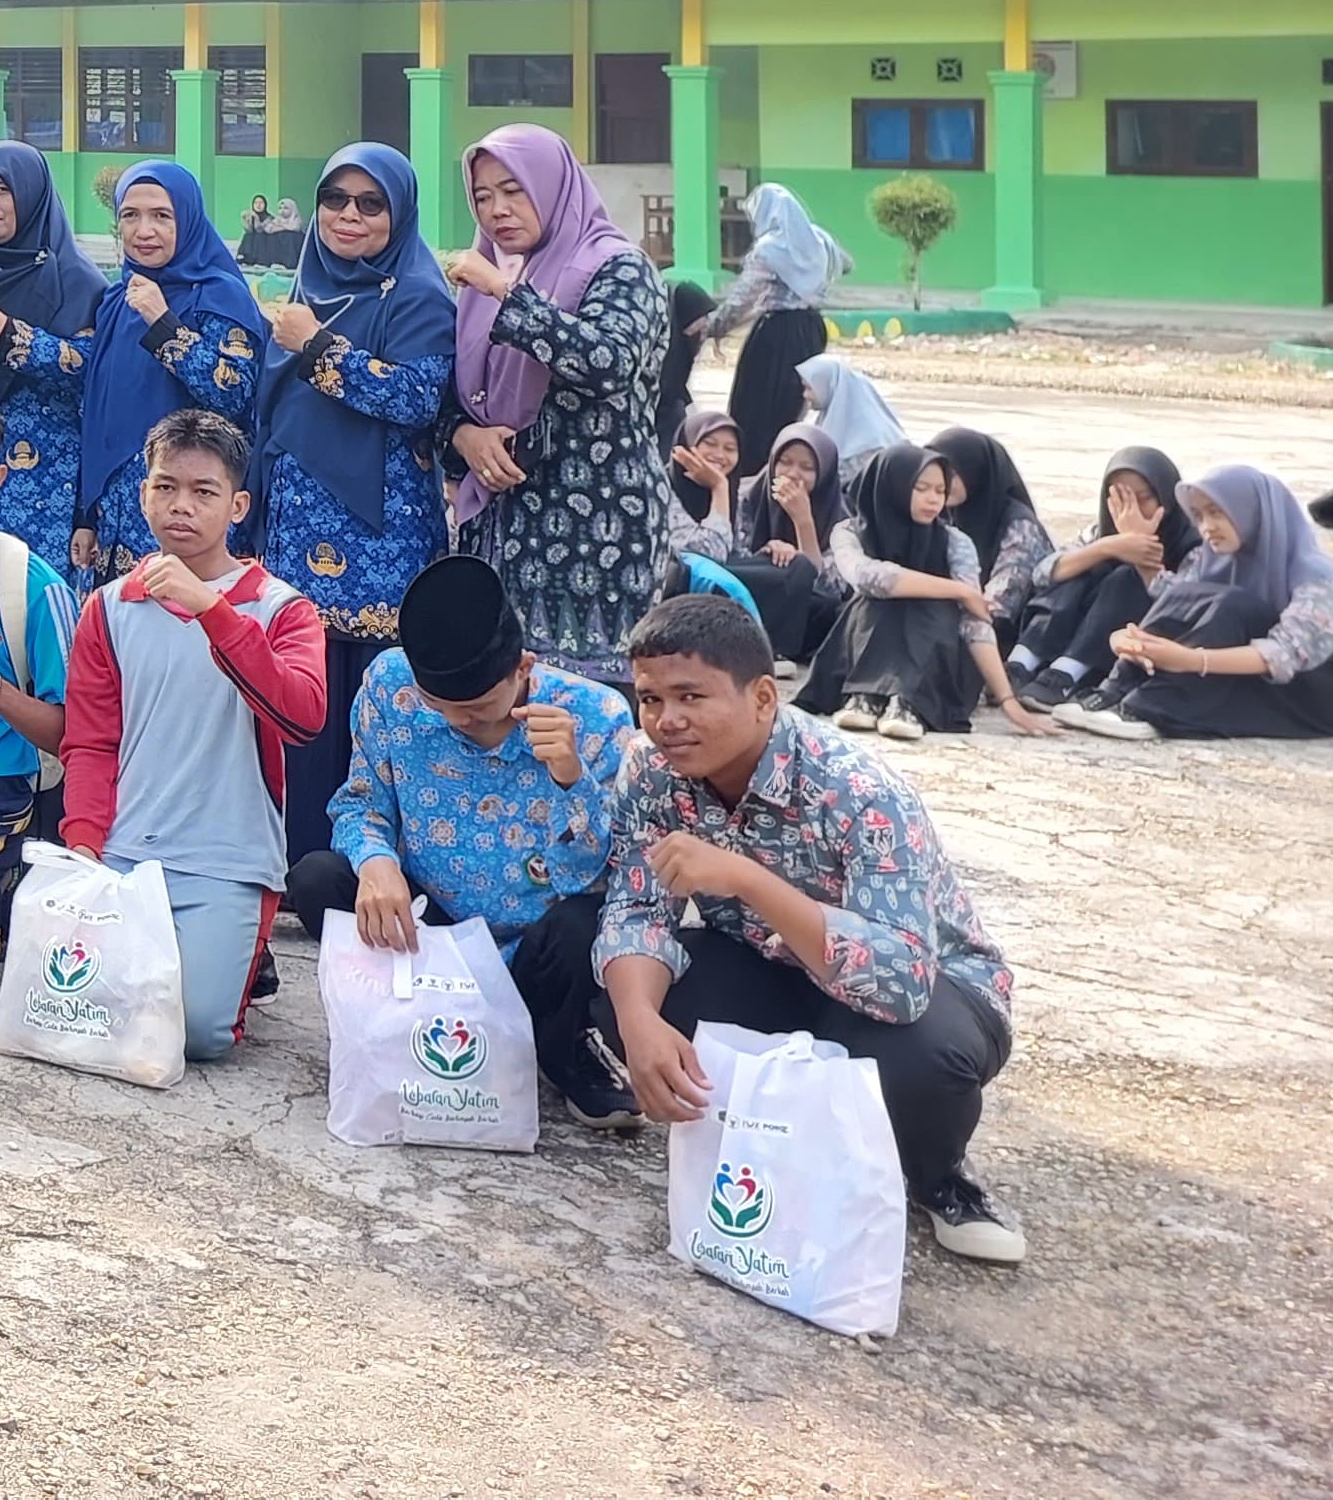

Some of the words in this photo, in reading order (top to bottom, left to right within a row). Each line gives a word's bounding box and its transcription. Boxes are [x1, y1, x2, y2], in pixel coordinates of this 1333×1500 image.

[64, 999, 110, 1025] Yatim
[402, 1083, 454, 1107] Lebaran
[452, 1087, 501, 1112] Yatim
[735, 1246, 790, 1279] Yatim
